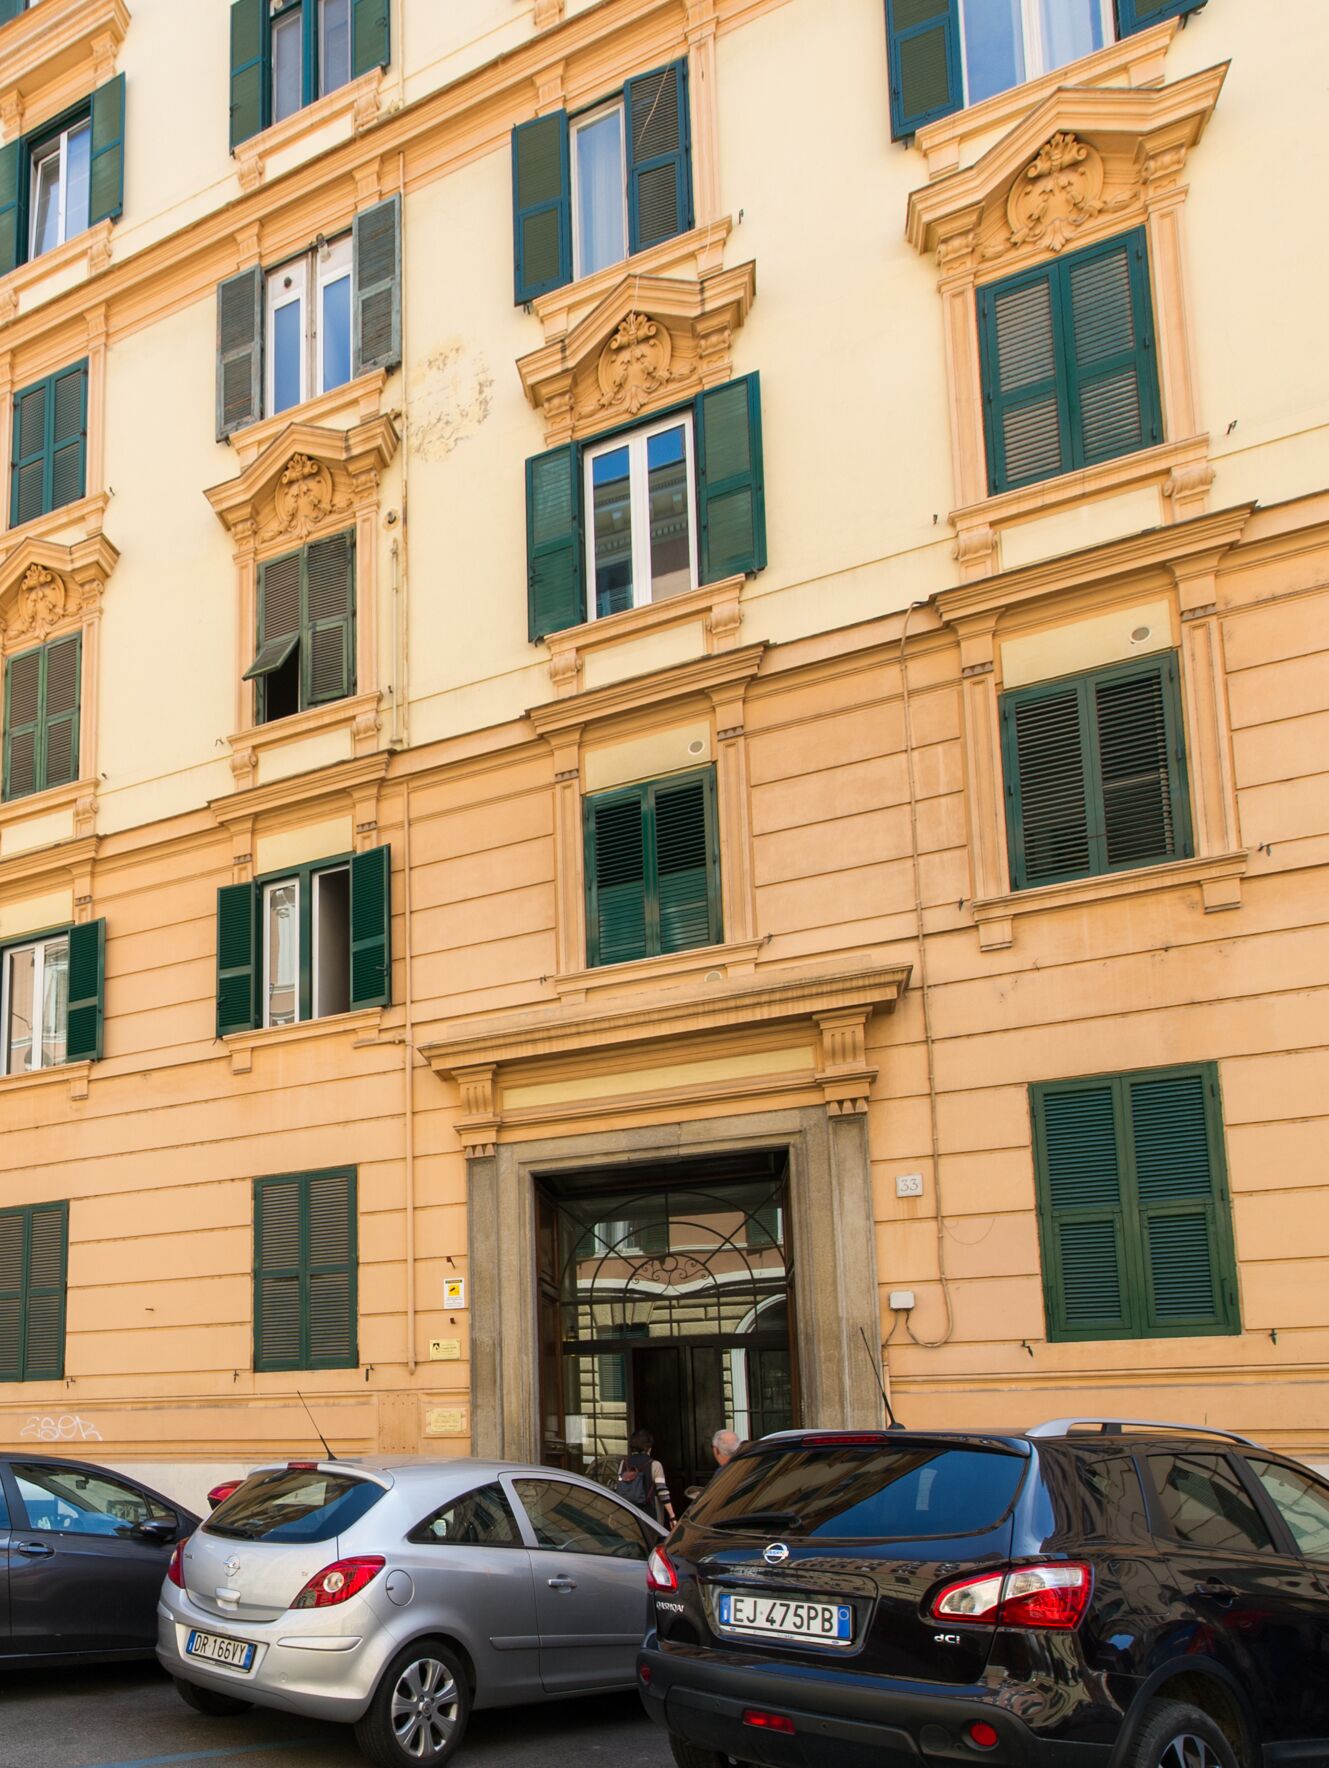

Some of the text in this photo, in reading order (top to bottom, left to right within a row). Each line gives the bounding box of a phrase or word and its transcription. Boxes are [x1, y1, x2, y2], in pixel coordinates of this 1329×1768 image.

[900, 1178, 919, 1191] 33
[733, 1598, 757, 1624] EJ
[765, 1602, 833, 1633] 475PB
[194, 1634, 209, 1654] DR
[212, 1638, 246, 1664] 166VY
[934, 1634, 961, 1644] dCi
